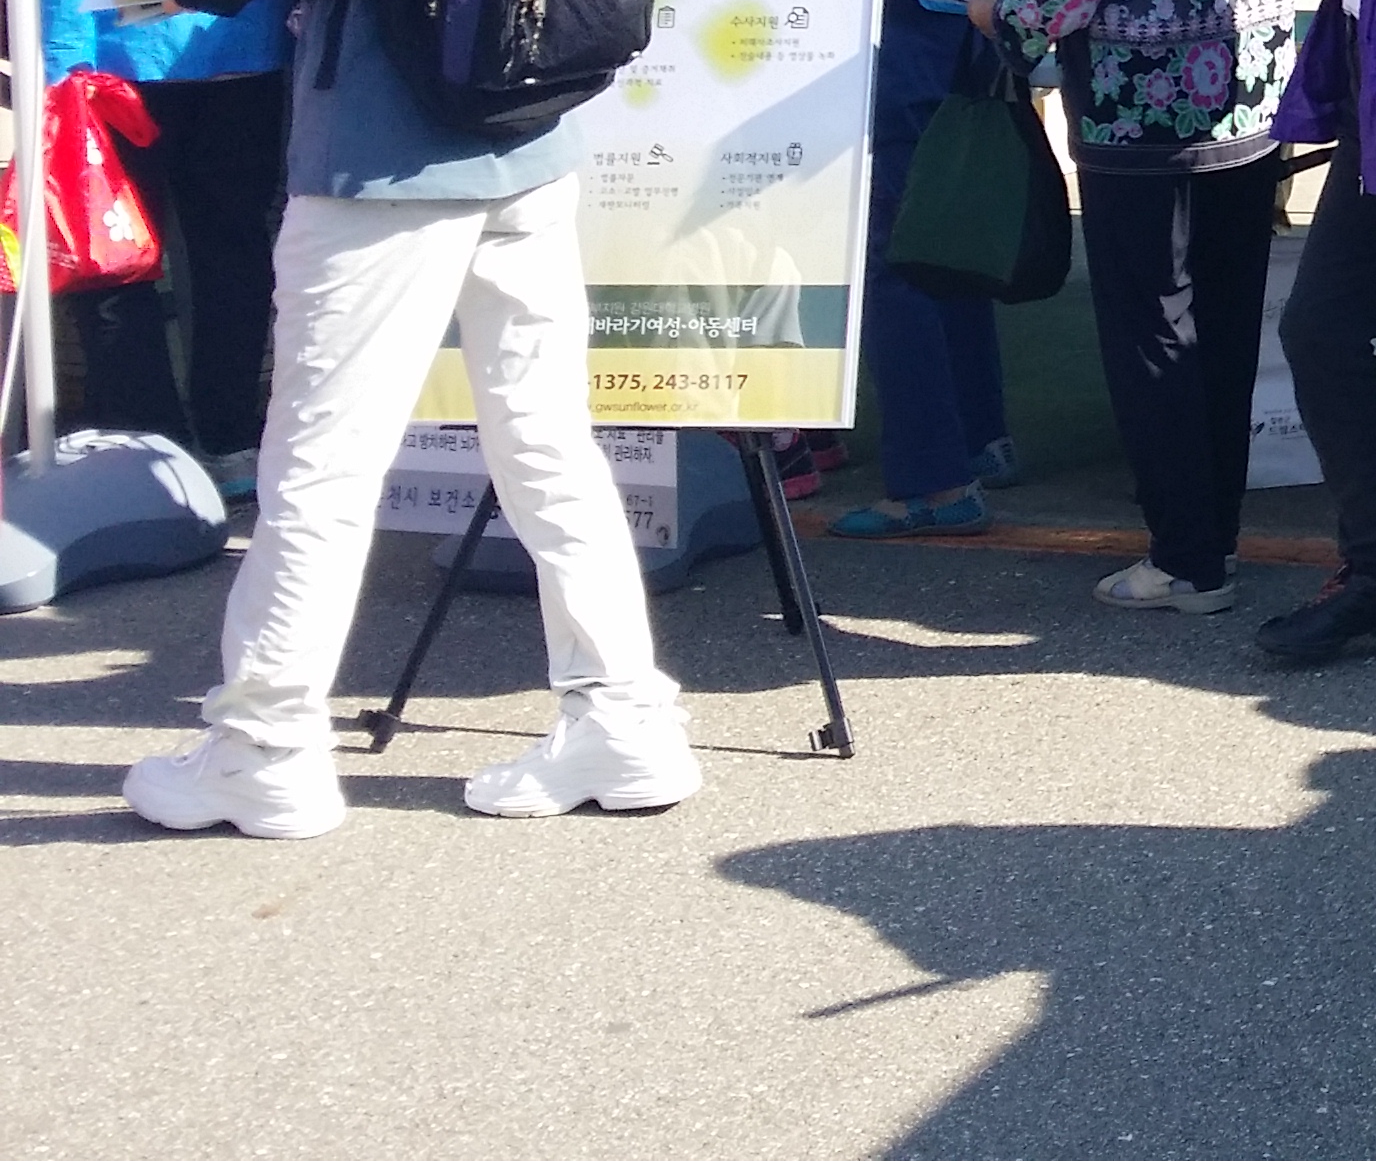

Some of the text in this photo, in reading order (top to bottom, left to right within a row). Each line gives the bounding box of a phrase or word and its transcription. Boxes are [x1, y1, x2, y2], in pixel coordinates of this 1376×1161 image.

[731, 16, 780, 30] 수사지원
[720, 152, 783, 167] 사회적지원
[652, 374, 749, 391] 243-8117
[427, 488, 475, 514] 보건소
